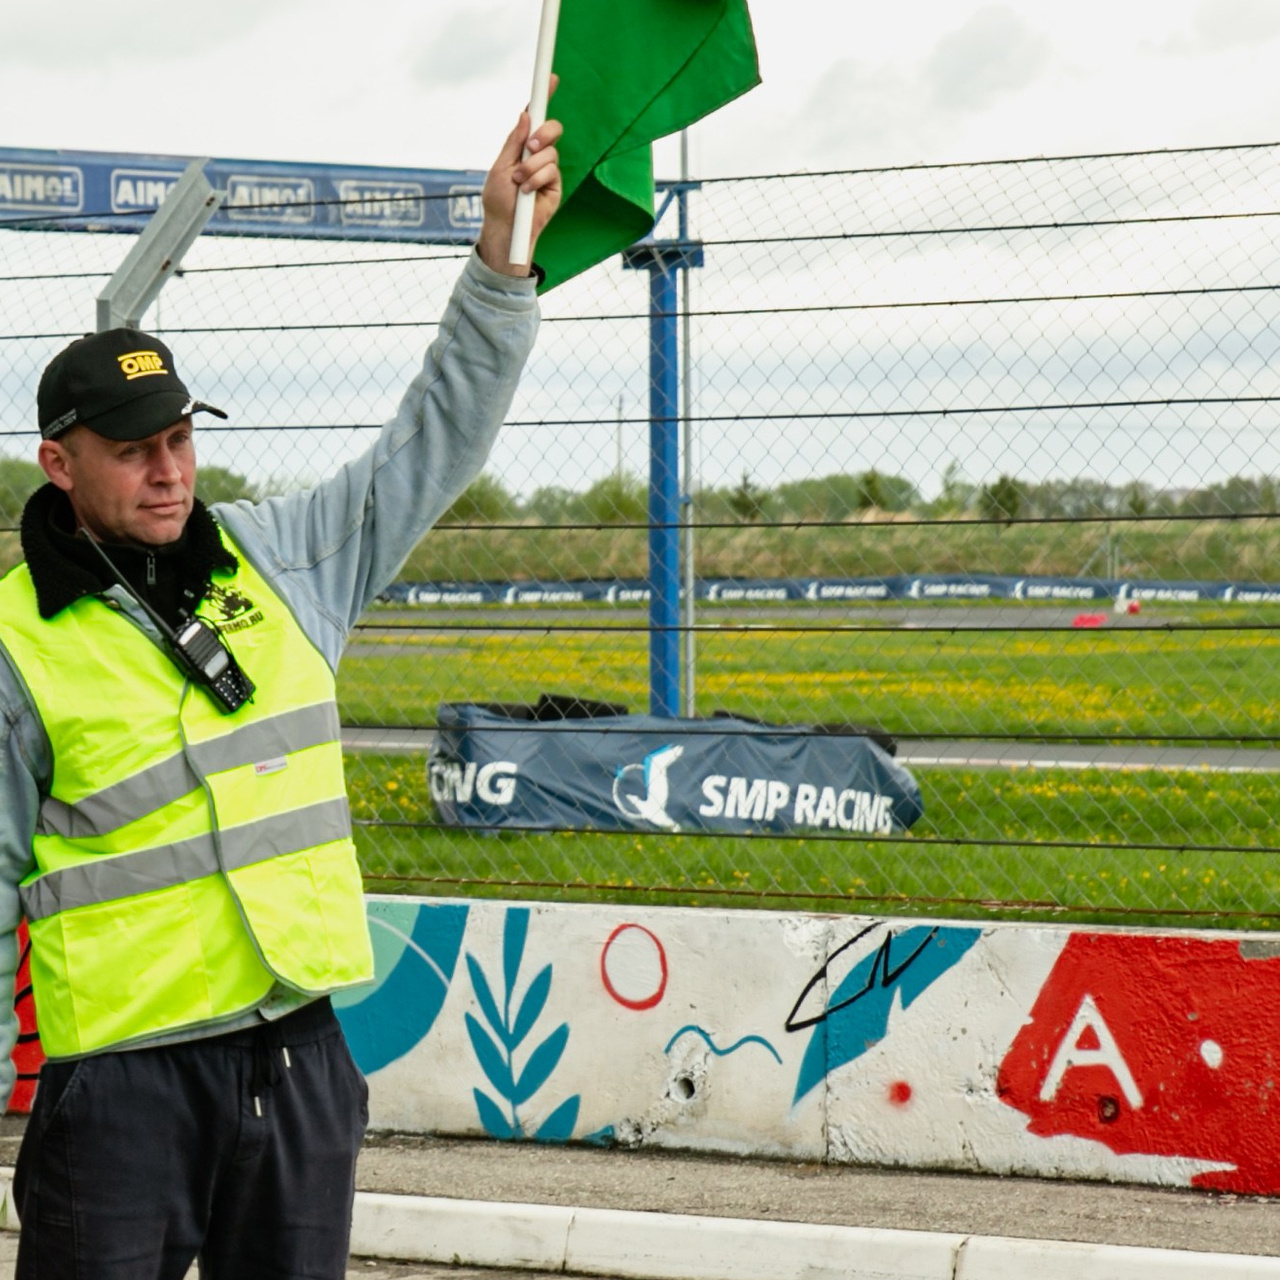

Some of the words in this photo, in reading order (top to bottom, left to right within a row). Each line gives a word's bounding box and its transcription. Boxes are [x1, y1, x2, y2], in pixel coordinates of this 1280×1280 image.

[121, 355, 163, 374] OMP
[699, 775, 789, 820] SMP
[795, 782, 894, 836] RACING
